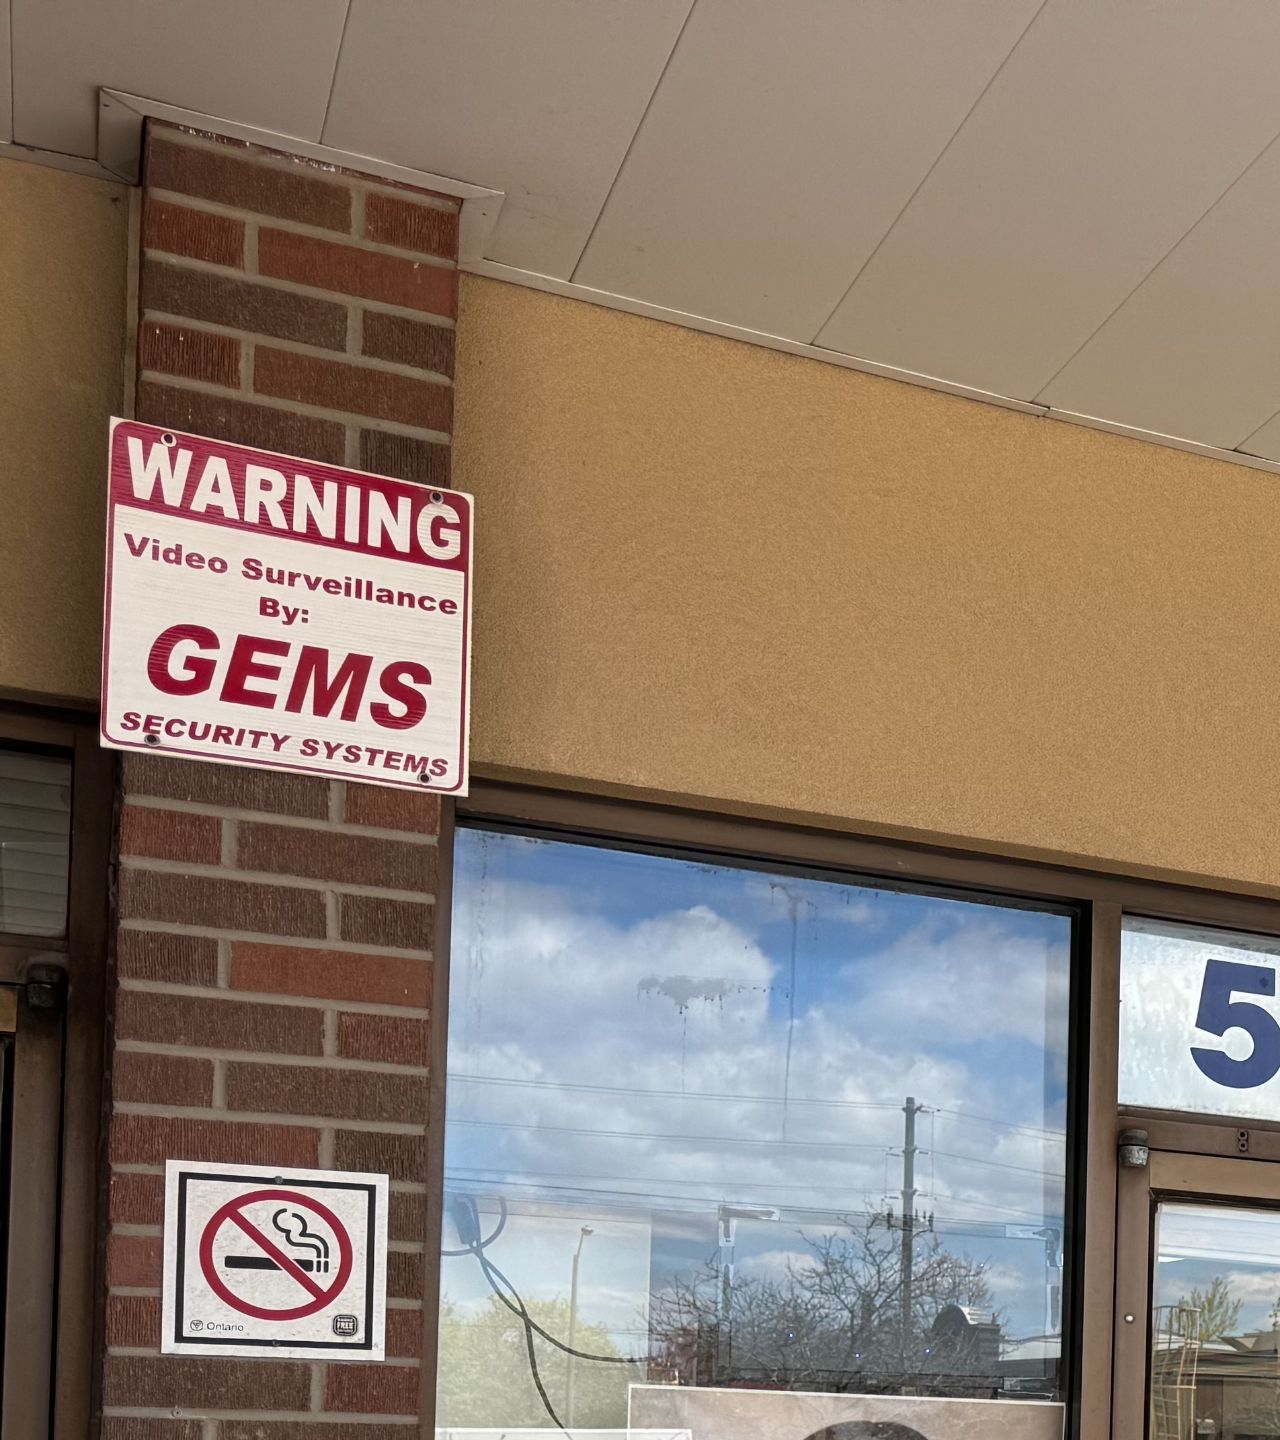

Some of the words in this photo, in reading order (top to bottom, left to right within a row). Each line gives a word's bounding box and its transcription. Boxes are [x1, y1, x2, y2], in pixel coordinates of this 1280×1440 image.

[127, 436, 462, 560] WARNING
[124, 533, 228, 575] Video
[241, 558, 458, 616] Surveillance
[258, 597, 310, 626] By:
[146, 623, 432, 730] GEMS
[120, 711, 290, 753] SECURITY
[300, 738, 449, 779] SYSTEMS
[206, 1322, 244, 1332] Ontario
